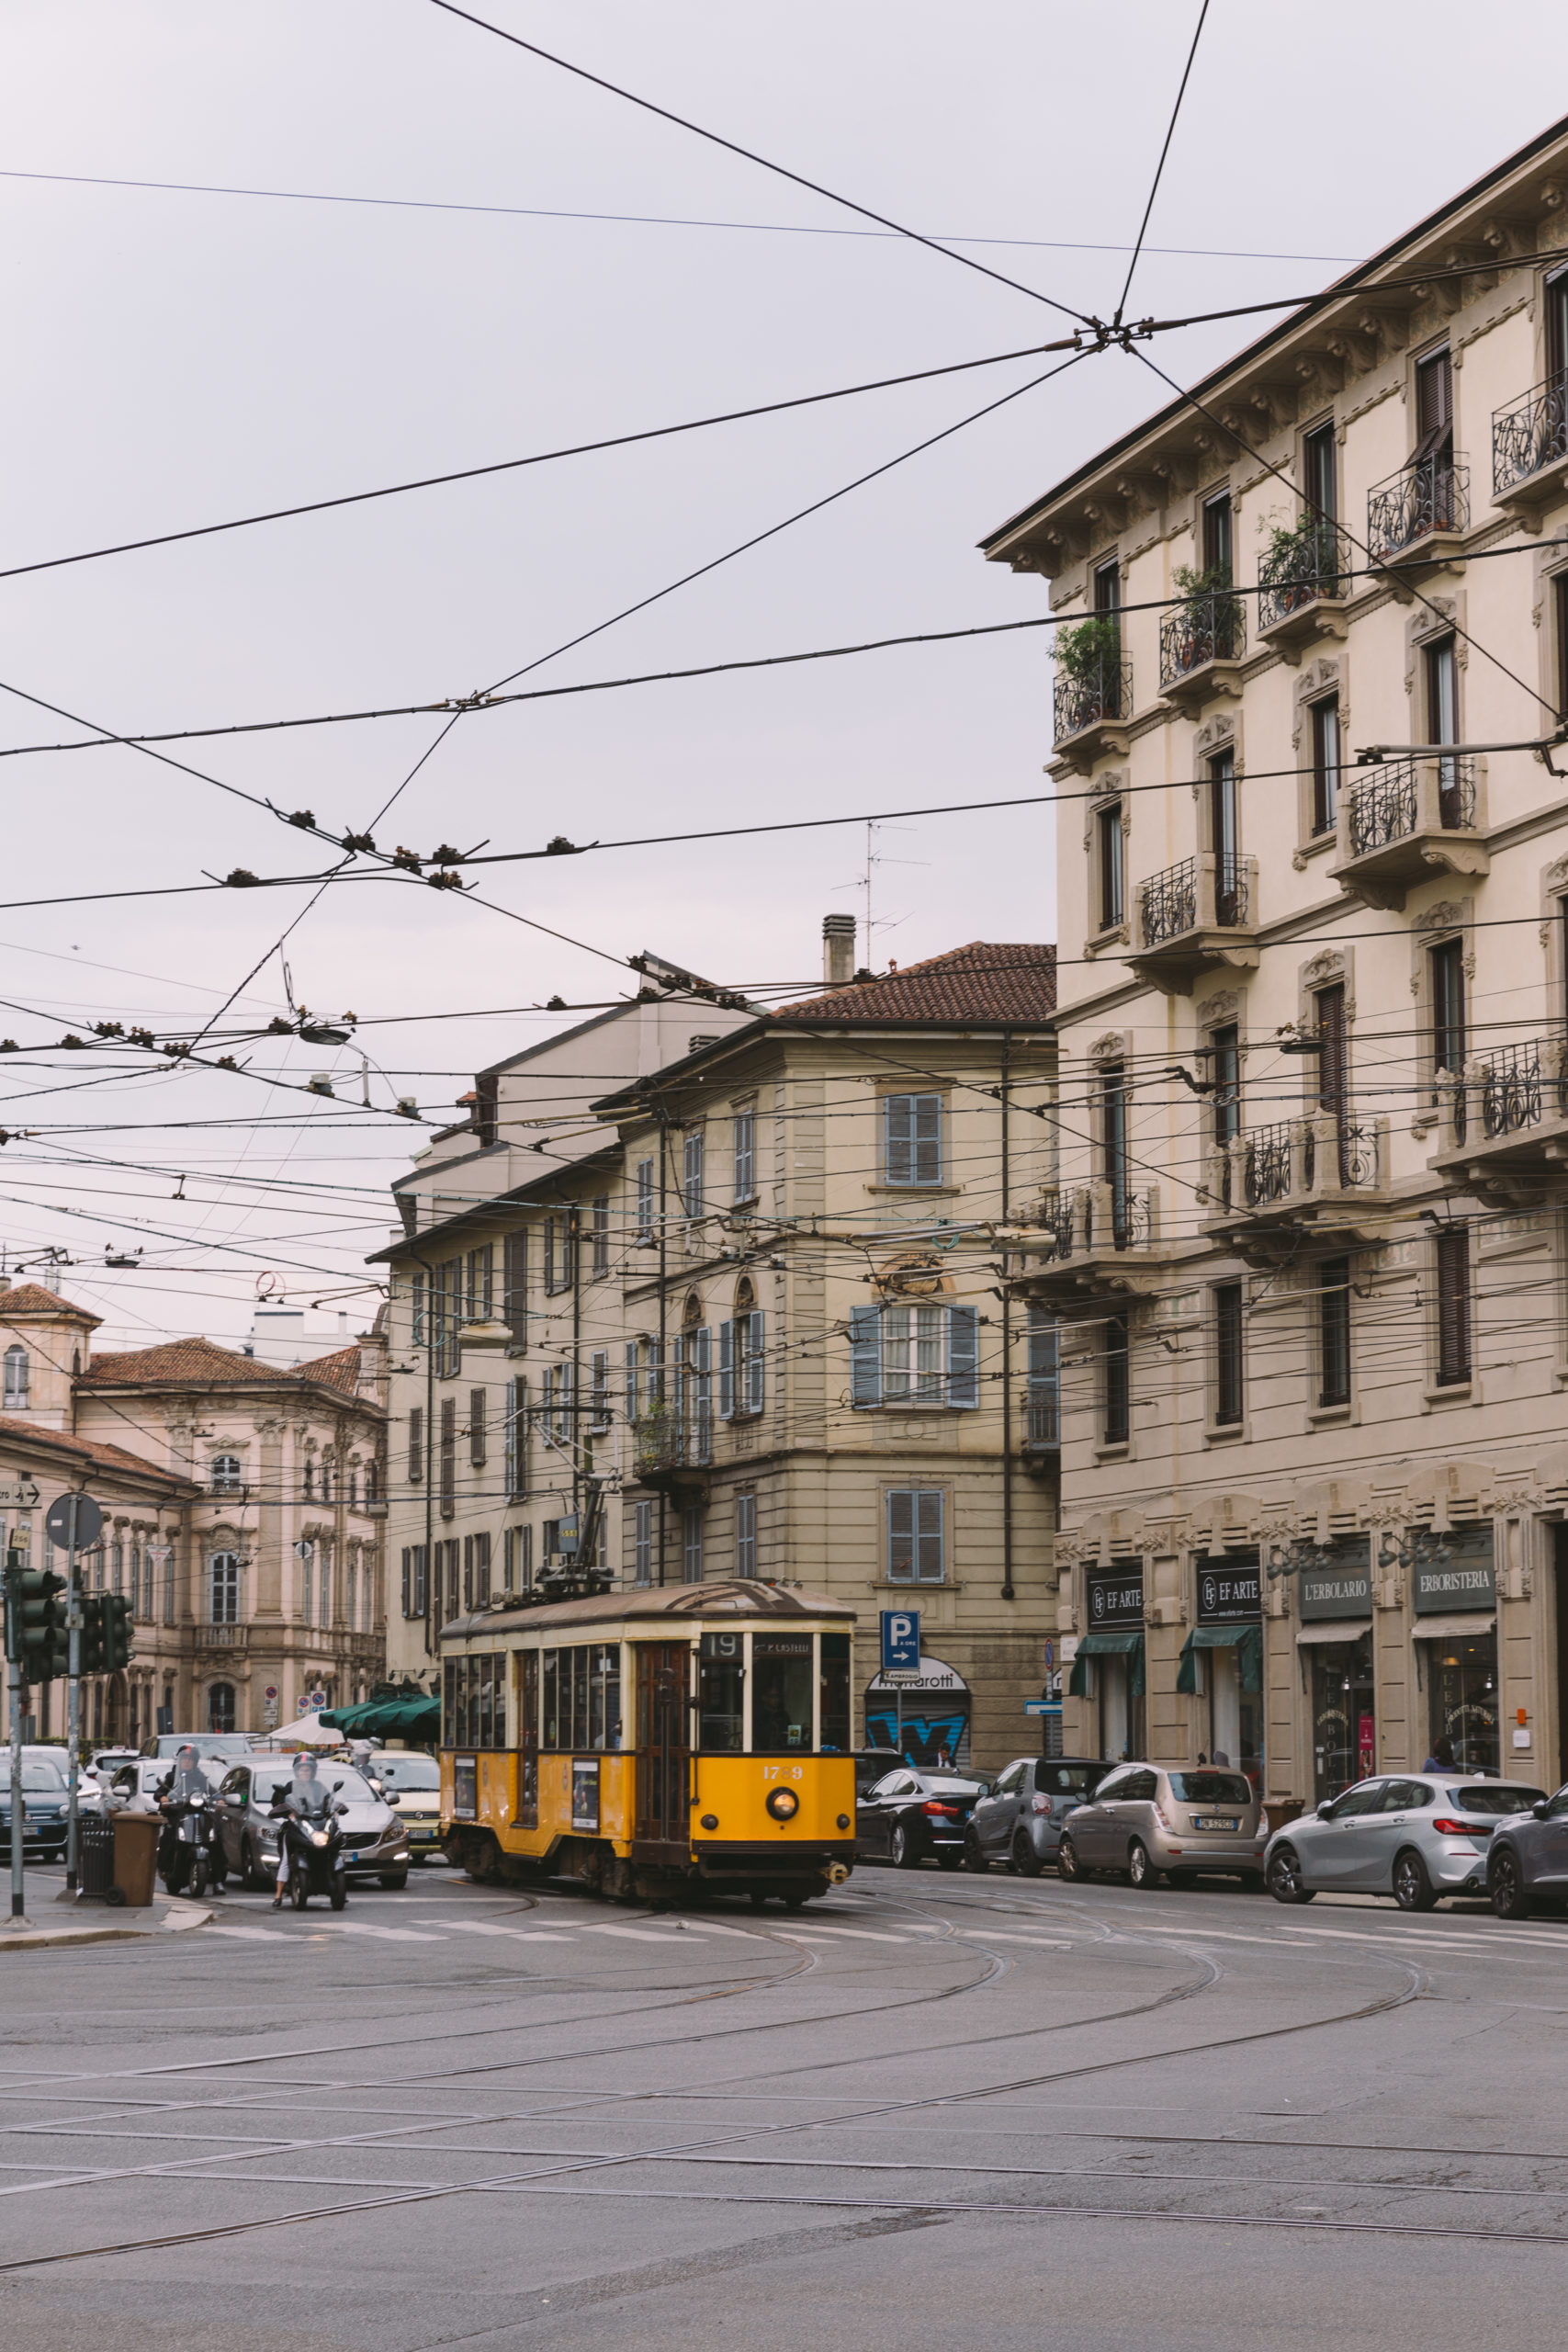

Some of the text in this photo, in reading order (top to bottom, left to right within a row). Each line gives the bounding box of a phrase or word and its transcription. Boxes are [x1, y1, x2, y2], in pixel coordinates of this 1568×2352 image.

[1219, 1580, 1258, 1600] EF ARTE
[1304, 1580, 1367, 1600] L'ERBOLARIO
[1420, 1571, 1490, 1592] ERBORISTERIA
[1107, 1589, 1142, 1609] EF ARTE
[891, 1618, 911, 1646] P
[710, 1634, 736, 1656] 19
[763, 1766, 804, 1780] 1789
